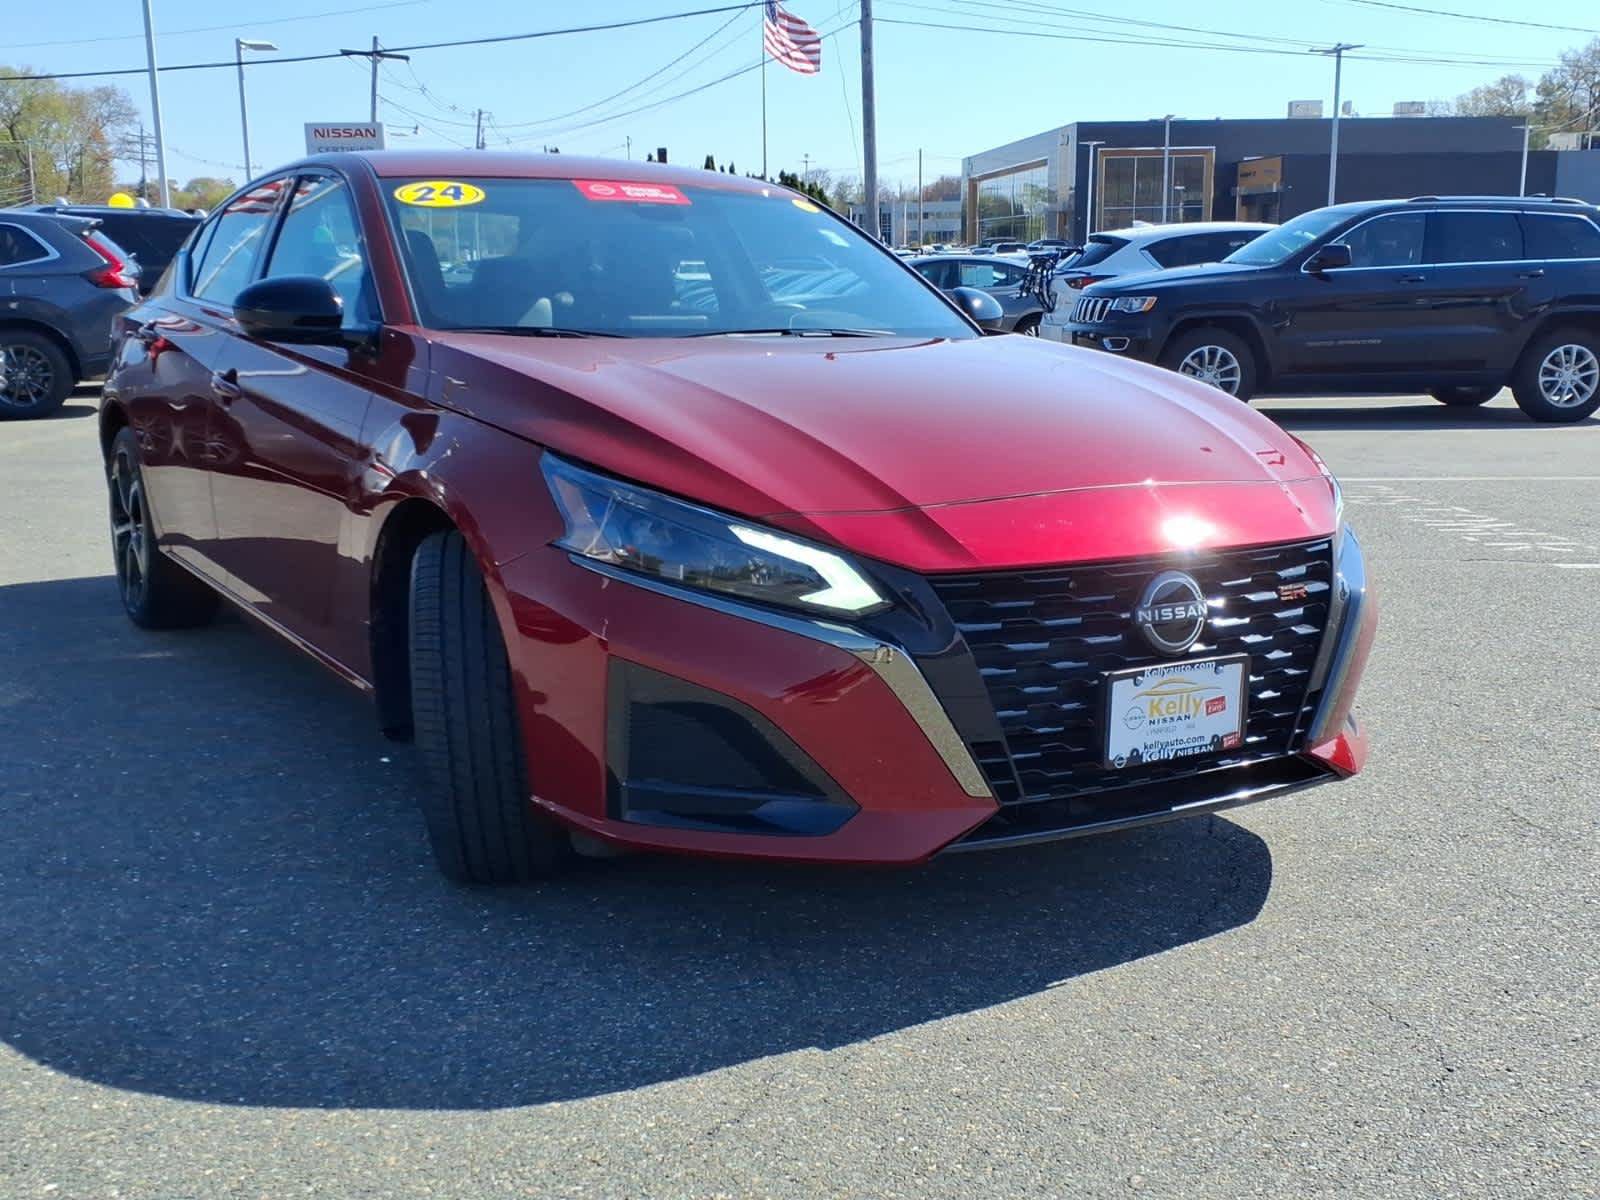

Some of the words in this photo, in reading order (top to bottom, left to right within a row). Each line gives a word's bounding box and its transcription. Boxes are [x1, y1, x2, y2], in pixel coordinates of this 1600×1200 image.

[313, 128, 377, 139] NISSAN
[412, 185, 464, 202] 24
[1137, 602, 1208, 623] NISSAN
[1148, 693, 1203, 718] Kelly
[1148, 714, 1191, 726] NISSAN
[1143, 735, 1206, 750] kellyauto.com
[1142, 749, 1176, 763] Kelly
[1176, 744, 1215, 757] NISSAN
